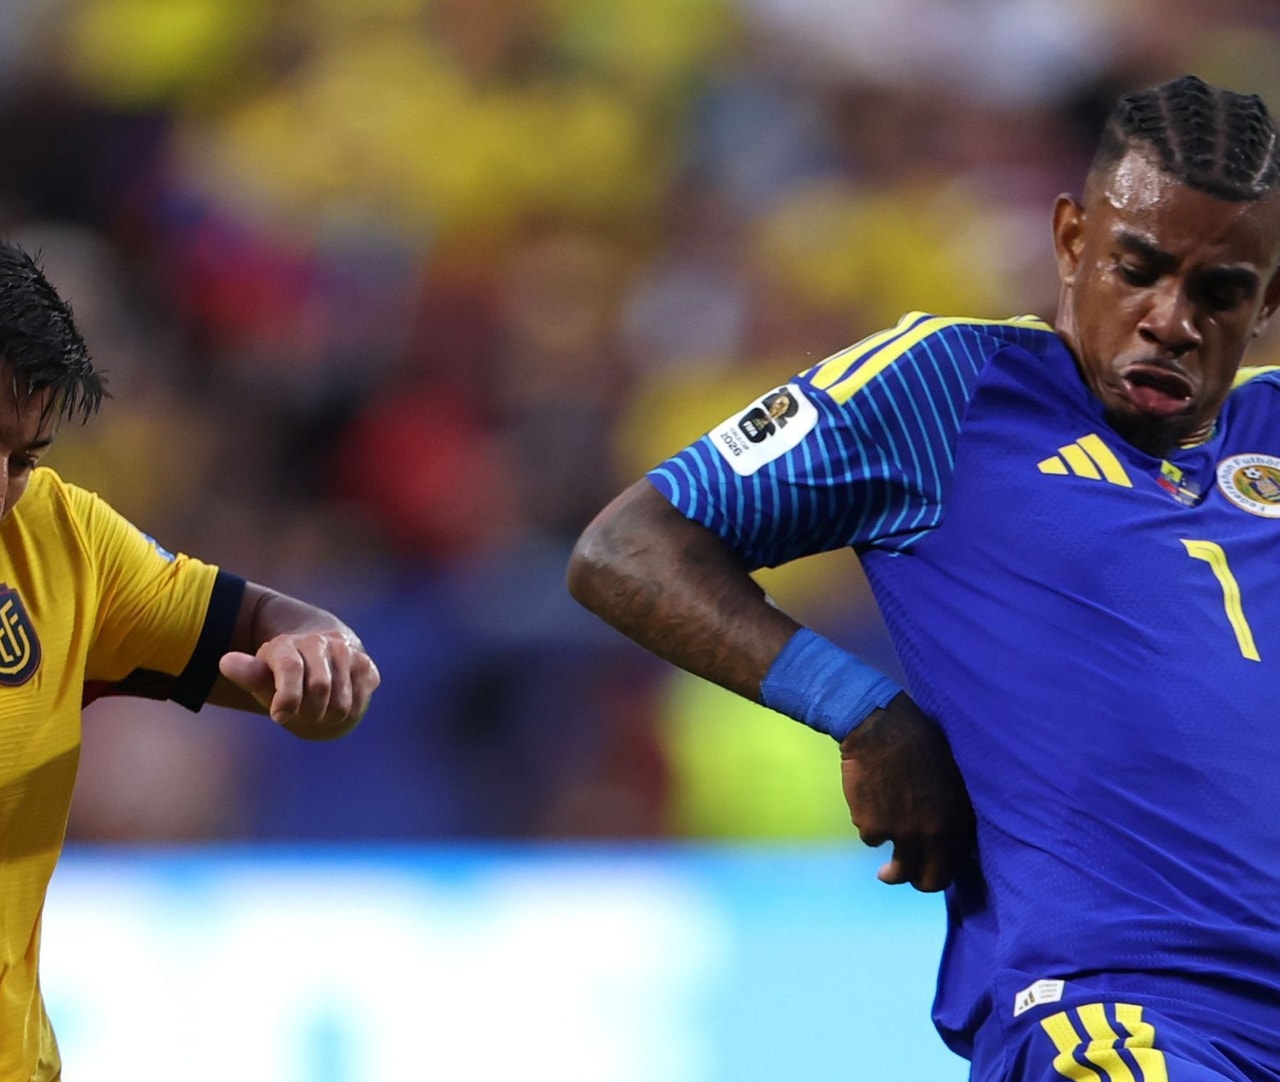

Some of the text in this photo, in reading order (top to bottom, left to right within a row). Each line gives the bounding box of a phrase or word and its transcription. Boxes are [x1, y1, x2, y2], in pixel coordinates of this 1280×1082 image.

[742, 420, 758, 438] FIFA
[720, 431, 744, 457] 2026
[1179, 538, 1262, 662] 7
